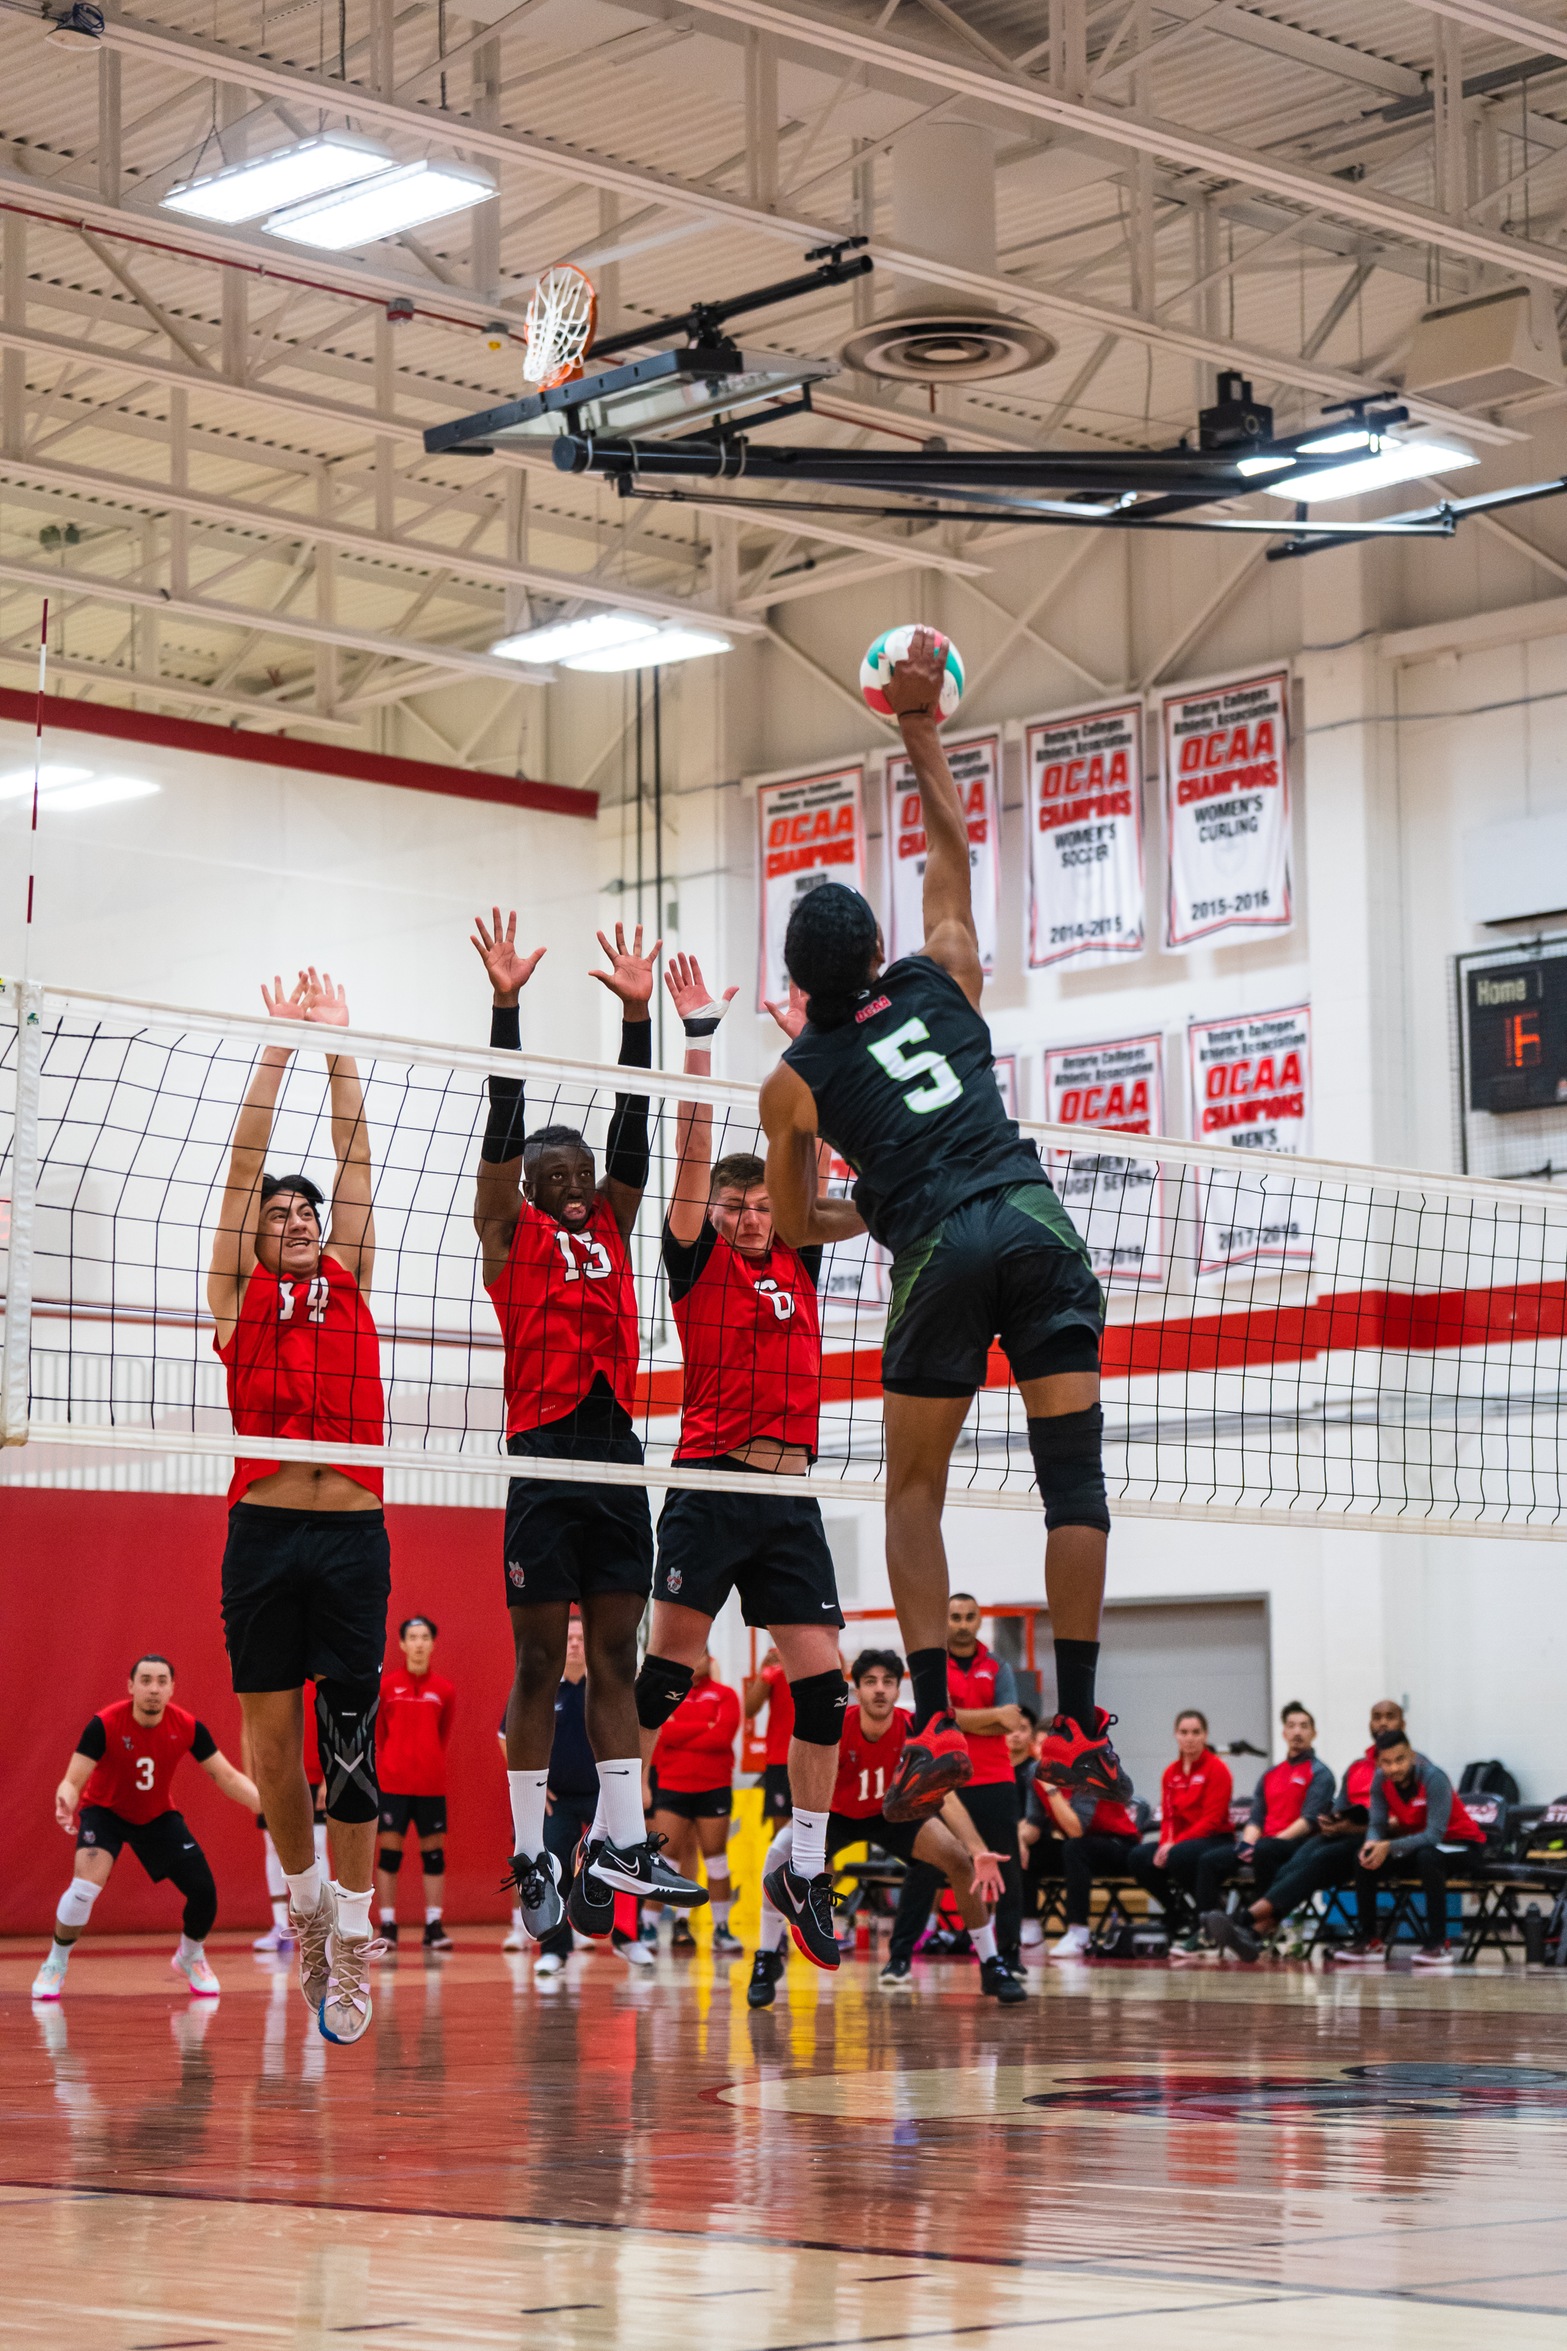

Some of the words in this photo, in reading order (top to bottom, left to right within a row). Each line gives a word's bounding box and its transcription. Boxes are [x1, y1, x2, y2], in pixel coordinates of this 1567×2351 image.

[1180, 719, 1275, 775] OCAA
[1041, 750, 1128, 800] OCAA
[1178, 760, 1278, 806] CHAMPIONS
[767, 804, 853, 849] OCAA
[1039, 790, 1131, 831] CHAMPIONS
[1194, 795, 1263, 823] WOMEN'S
[1199, 816, 1258, 842] CURLING
[1191, 890, 1269, 920] 2015-2016
[855, 994, 892, 1023] OCAA
[1477, 979, 1526, 1006] Home
[866, 1016, 964, 1114] 5
[1205, 1052, 1302, 1102] OCAA
[1058, 1080, 1148, 1124] OCAA
[1202, 1092, 1305, 1133] CHAMPIONS
[1231, 1128, 1278, 1147] MEN'S
[554, 1231, 612, 1282] 15
[279, 1276, 330, 1323] 14
[135, 1756, 155, 1791] 3
[858, 1766, 885, 1801] 11
